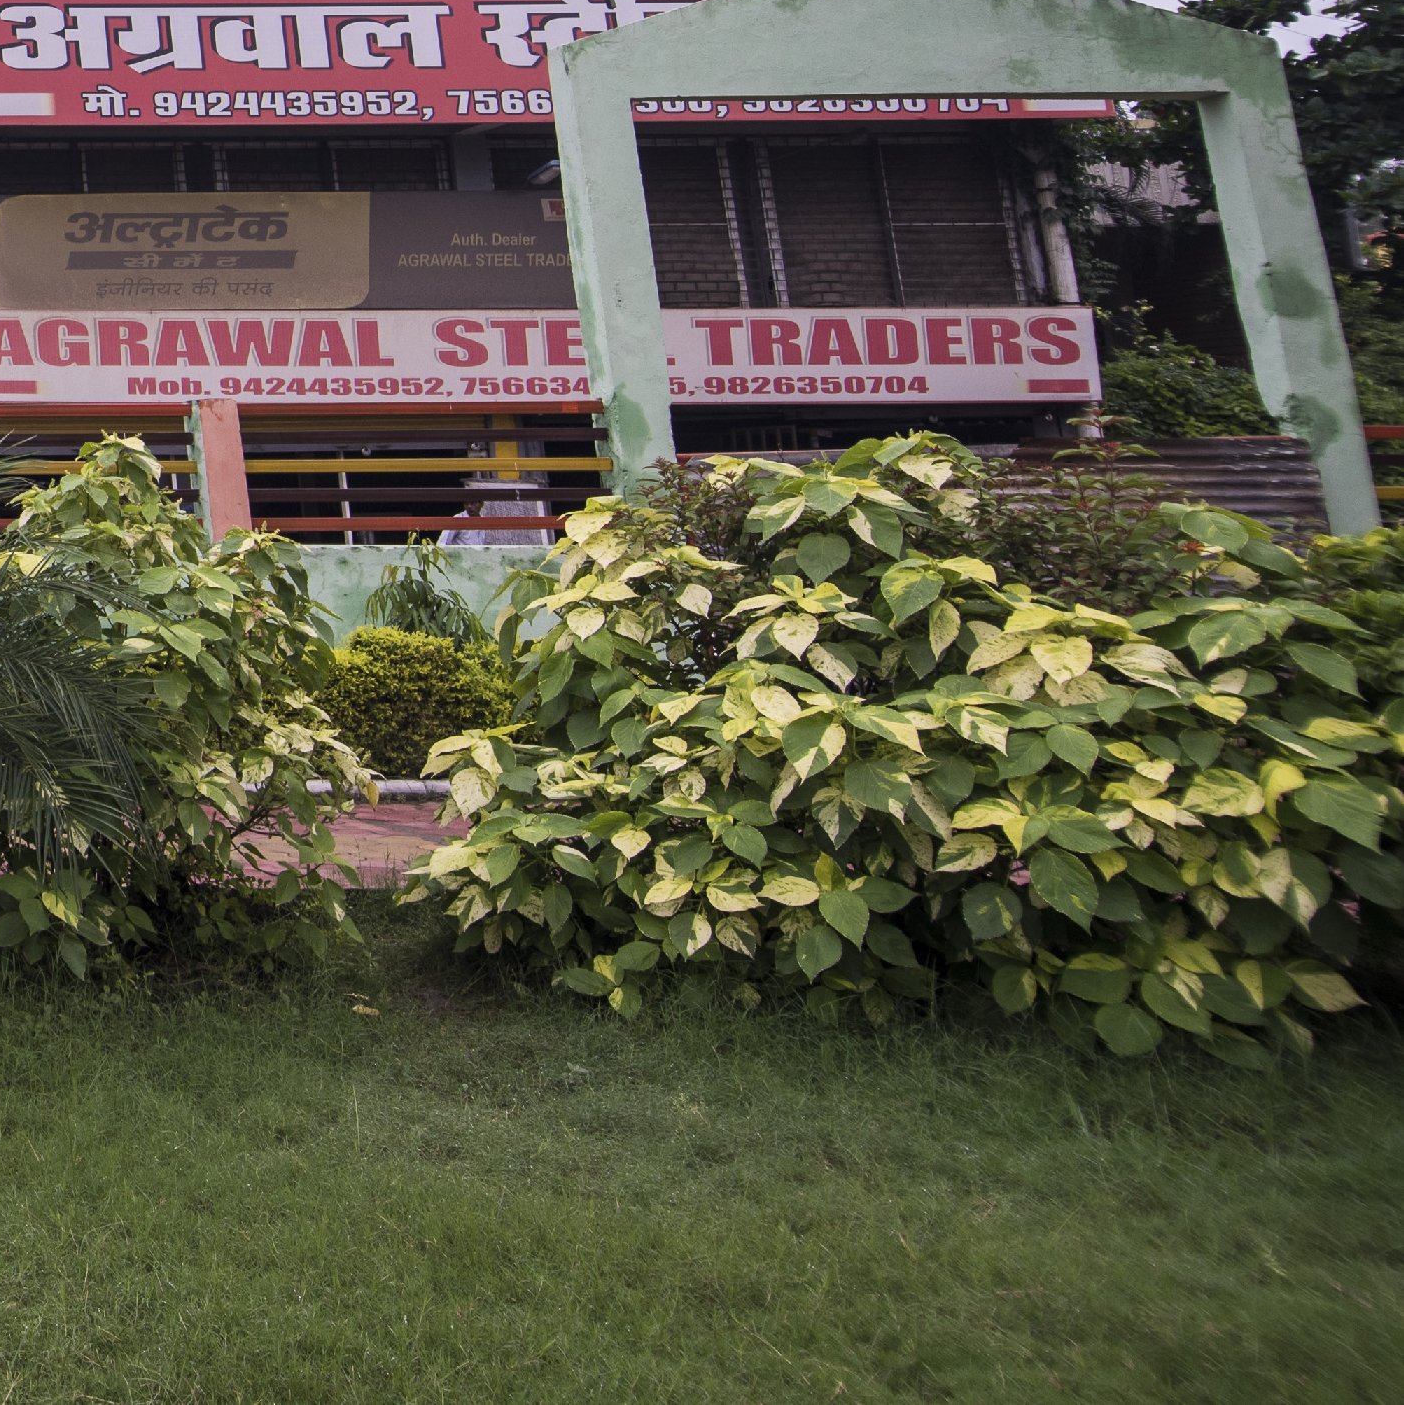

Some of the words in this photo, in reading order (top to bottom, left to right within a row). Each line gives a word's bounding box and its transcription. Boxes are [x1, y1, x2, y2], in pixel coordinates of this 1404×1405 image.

[81, 85, 140, 116] मो.
[153, 89, 434, 120] 9424435952,
[450, 233, 488, 247] Auth.
[492, 232, 537, 247] Dealer
[398, 253, 472, 268] AGRAWAL
[475, 253, 522, 268] STEEL
[693, 316, 1082, 366] TRADERS
[126, 376, 210, 396] Mob.
[218, 375, 454, 398] 9424435952,
[702, 375, 930, 394] 9826350704
